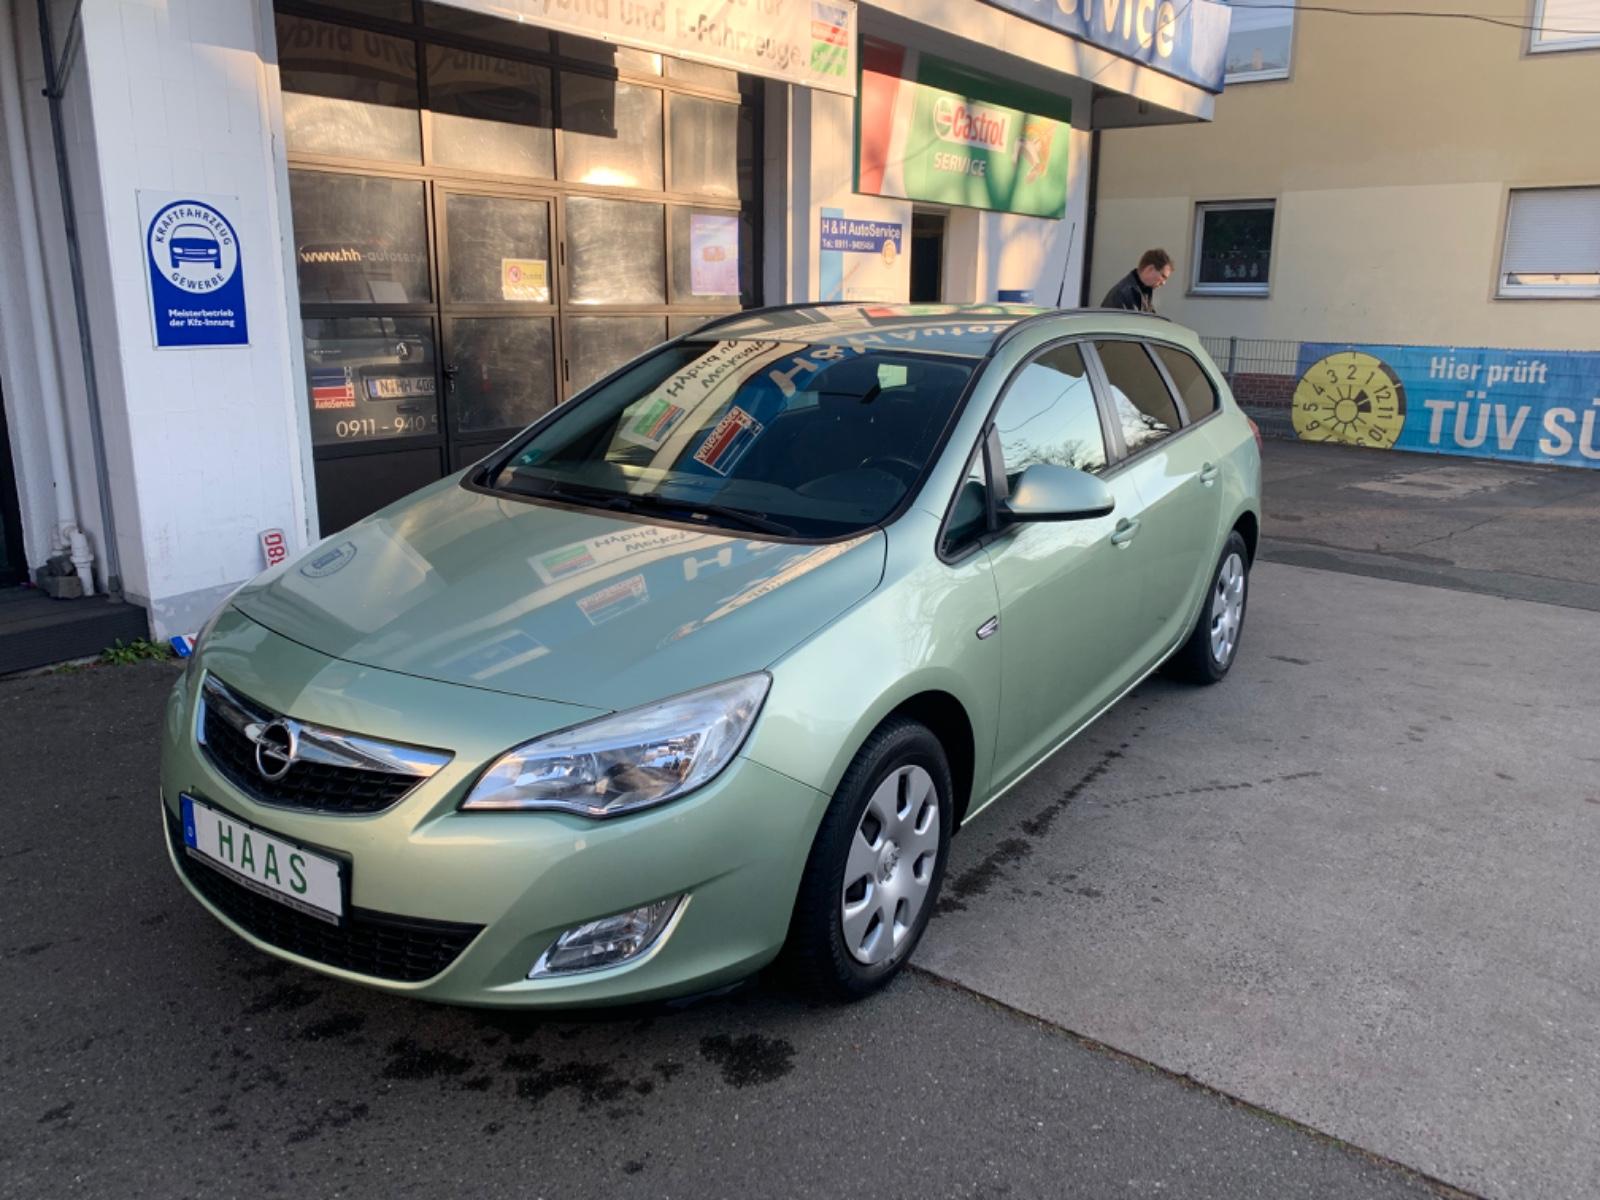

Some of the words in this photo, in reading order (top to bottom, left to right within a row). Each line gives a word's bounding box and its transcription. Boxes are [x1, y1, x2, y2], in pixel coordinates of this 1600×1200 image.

[619, 0, 665, 32] und
[1034, 0, 1176, 58] vice
[952, 105, 1006, 147] Castrol
[934, 151, 986, 177] SERVICE
[155, 207, 232, 246] KRAFTFAHRZEUG
[822, 219, 830, 234] H
[840, 221, 847, 236] H
[848, 222, 901, 240] AutoService
[171, 272, 225, 290] GEWERBE
[167, 308, 235, 319] Meisterbetrieb
[169, 318, 185, 328] der
[187, 318, 236, 329] Kfz-Innung
[1326, 369, 1339, 384] 3
[1346, 364, 1357, 380] 2
[1366, 371, 1376, 385] 1
[1429, 356, 1482, 381] Hier
[1486, 360, 1548, 388] prüft
[1312, 383, 1326, 396] 4
[1373, 385, 1392, 403] 12
[315, 399, 355, 410] AutoService
[1303, 402, 1319, 413] 5
[1377, 406, 1395, 420] 11
[336, 418, 376, 438] 0911
[394, 415, 426, 435] 940
[1424, 389, 1532, 451] TÜV
[1367, 423, 1388, 442] 10
[217, 819, 308, 895] HAAS
